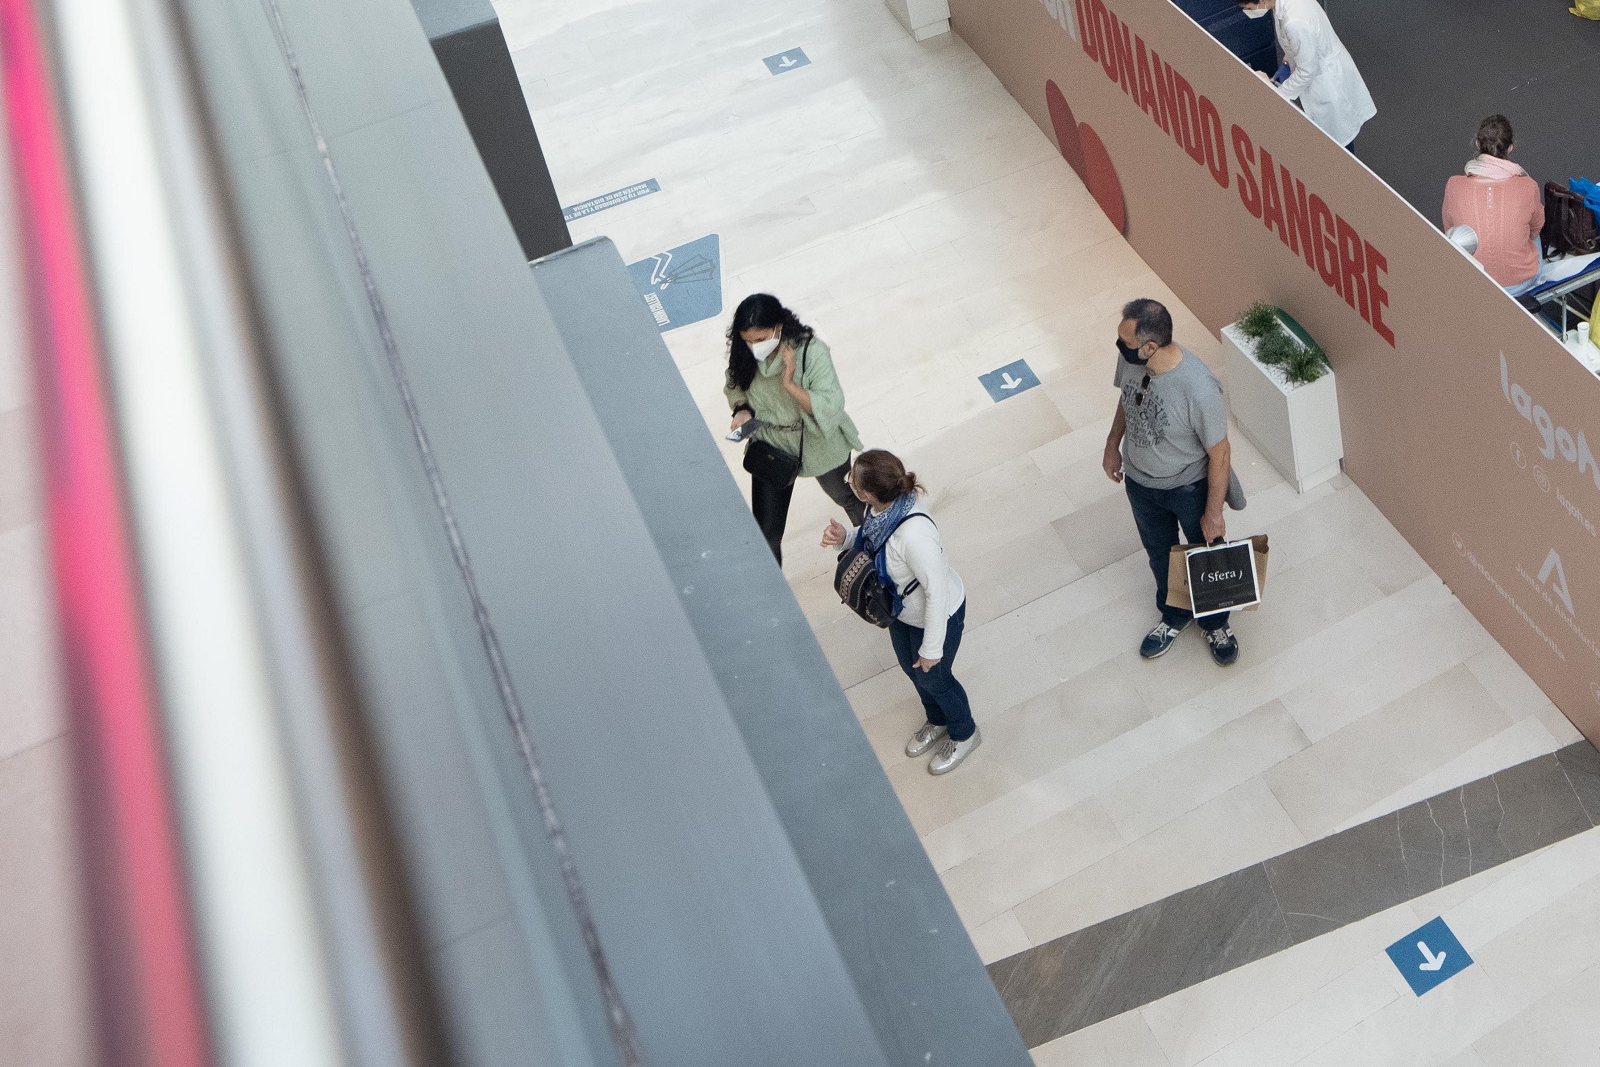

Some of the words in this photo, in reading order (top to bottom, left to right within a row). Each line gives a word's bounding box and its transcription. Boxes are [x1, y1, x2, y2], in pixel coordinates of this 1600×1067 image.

[1231, 123, 1396, 350] SANGRE
[1499, 349, 1600, 491] lagoh
[1556, 486, 1597, 537] lagoh.es
[1208, 570, 1236, 583] Sfera
[1515, 562, 1542, 593] Junta
[1542, 589, 1553, 606] de
